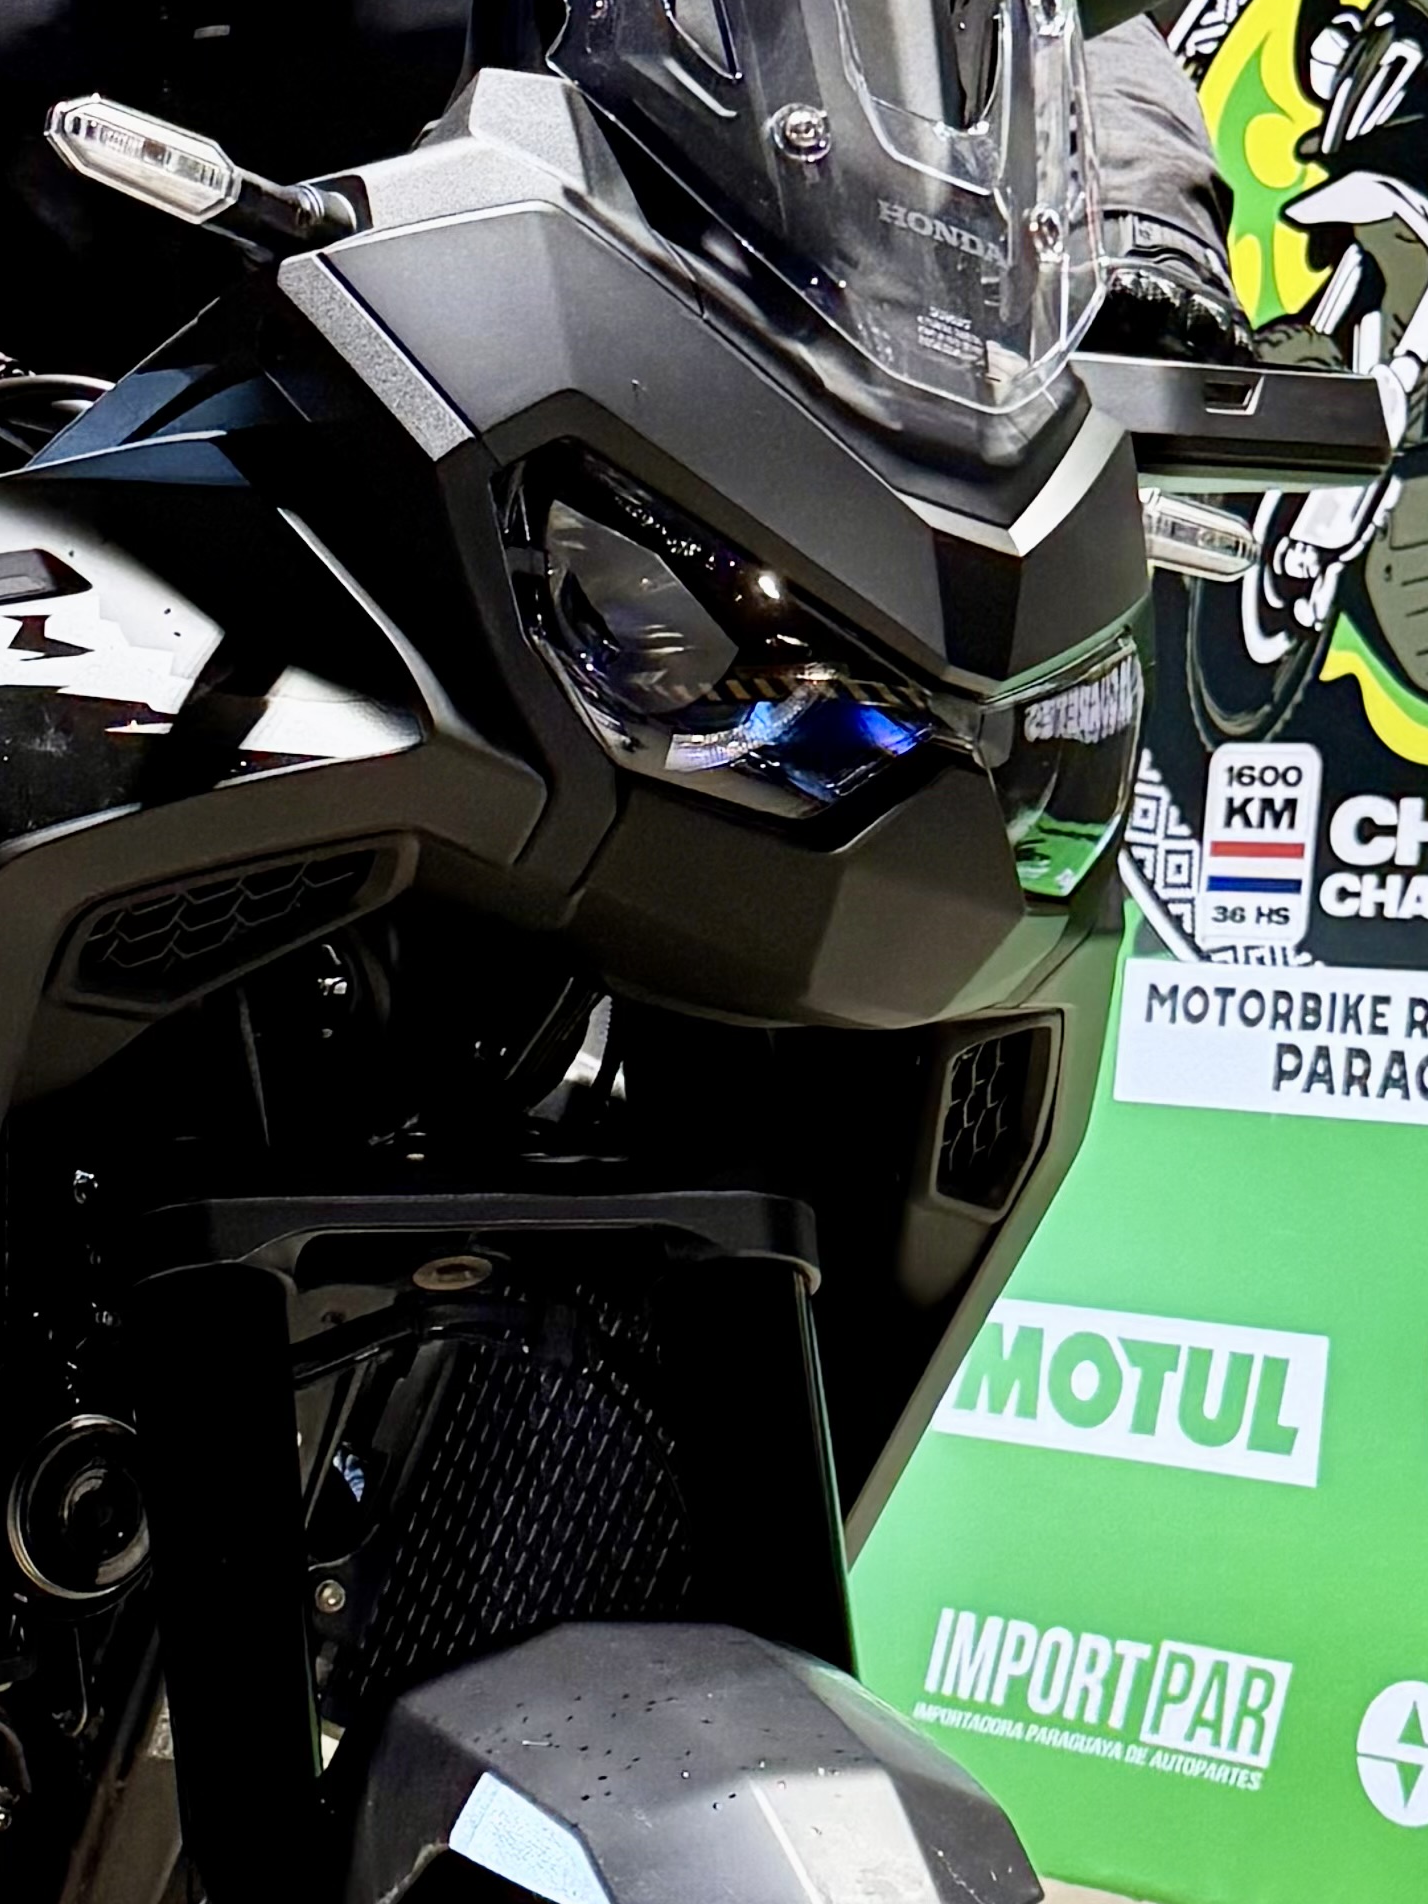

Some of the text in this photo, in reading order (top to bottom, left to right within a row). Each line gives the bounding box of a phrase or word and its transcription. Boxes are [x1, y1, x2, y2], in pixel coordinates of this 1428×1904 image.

[877, 198, 1006, 263] HONDA
[1225, 764, 1303, 787] 1600
[1223, 796, 1299, 830] KM
[1211, 905, 1290, 926] 36 HS
[1144, 981, 1390, 1036] MOTORBIKE
[953, 1321, 1300, 1457] MOTUL
[912, 1701, 1264, 1792] IMPORTADORA PARAGUAYA DE AUTOPARTES
